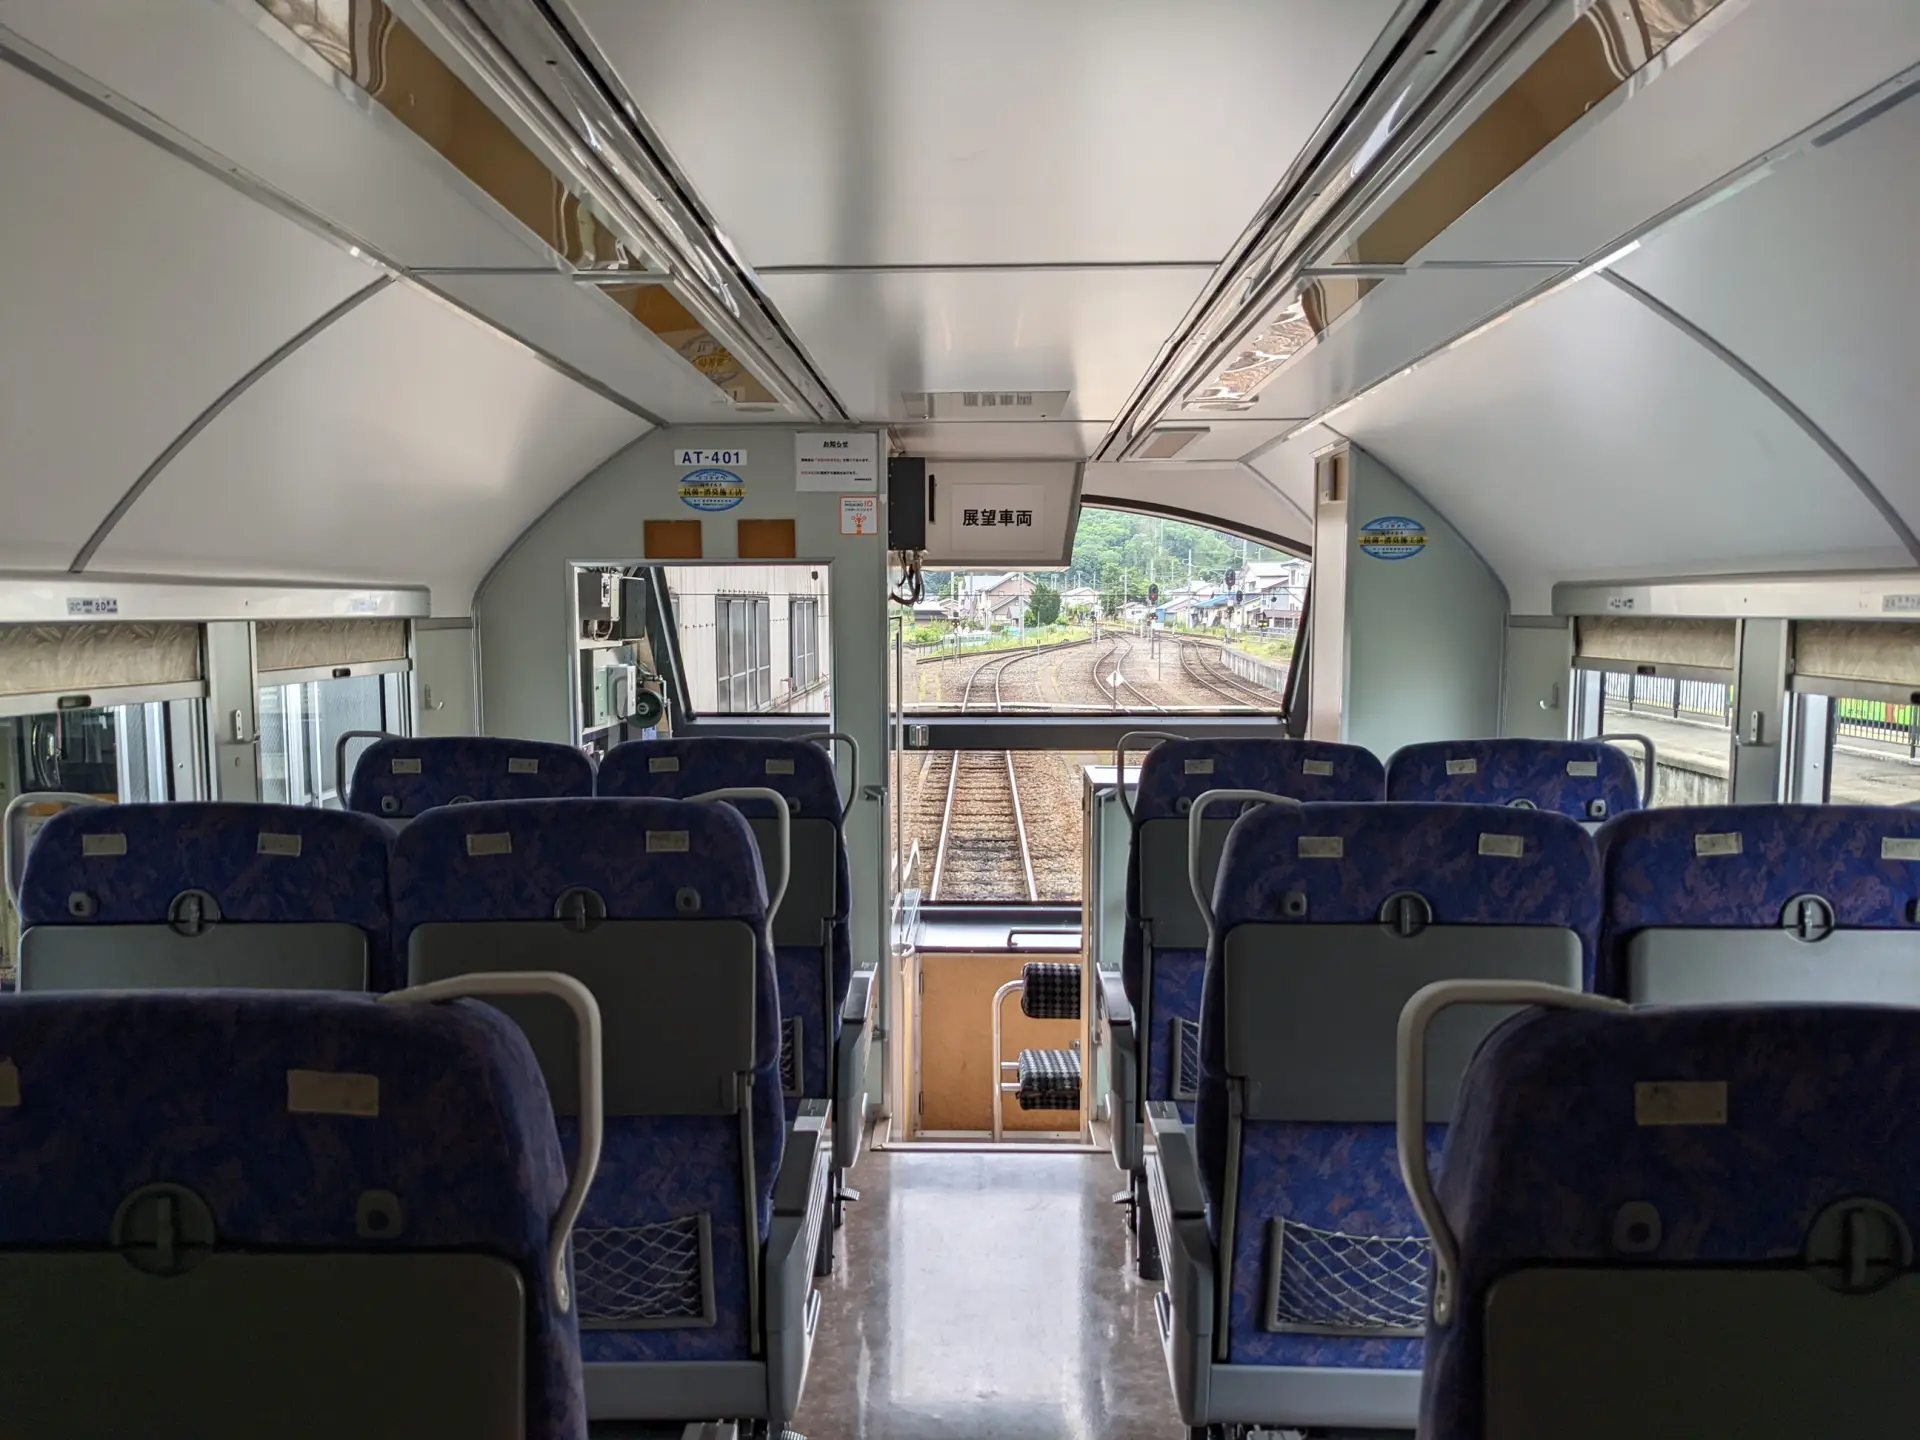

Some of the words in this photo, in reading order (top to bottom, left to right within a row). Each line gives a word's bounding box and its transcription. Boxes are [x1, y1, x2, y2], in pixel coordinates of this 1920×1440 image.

[823, 441, 849, 449] お知らせ
[682, 451, 740, 464] AT-401
[962, 509, 1033, 527] 展望車両
